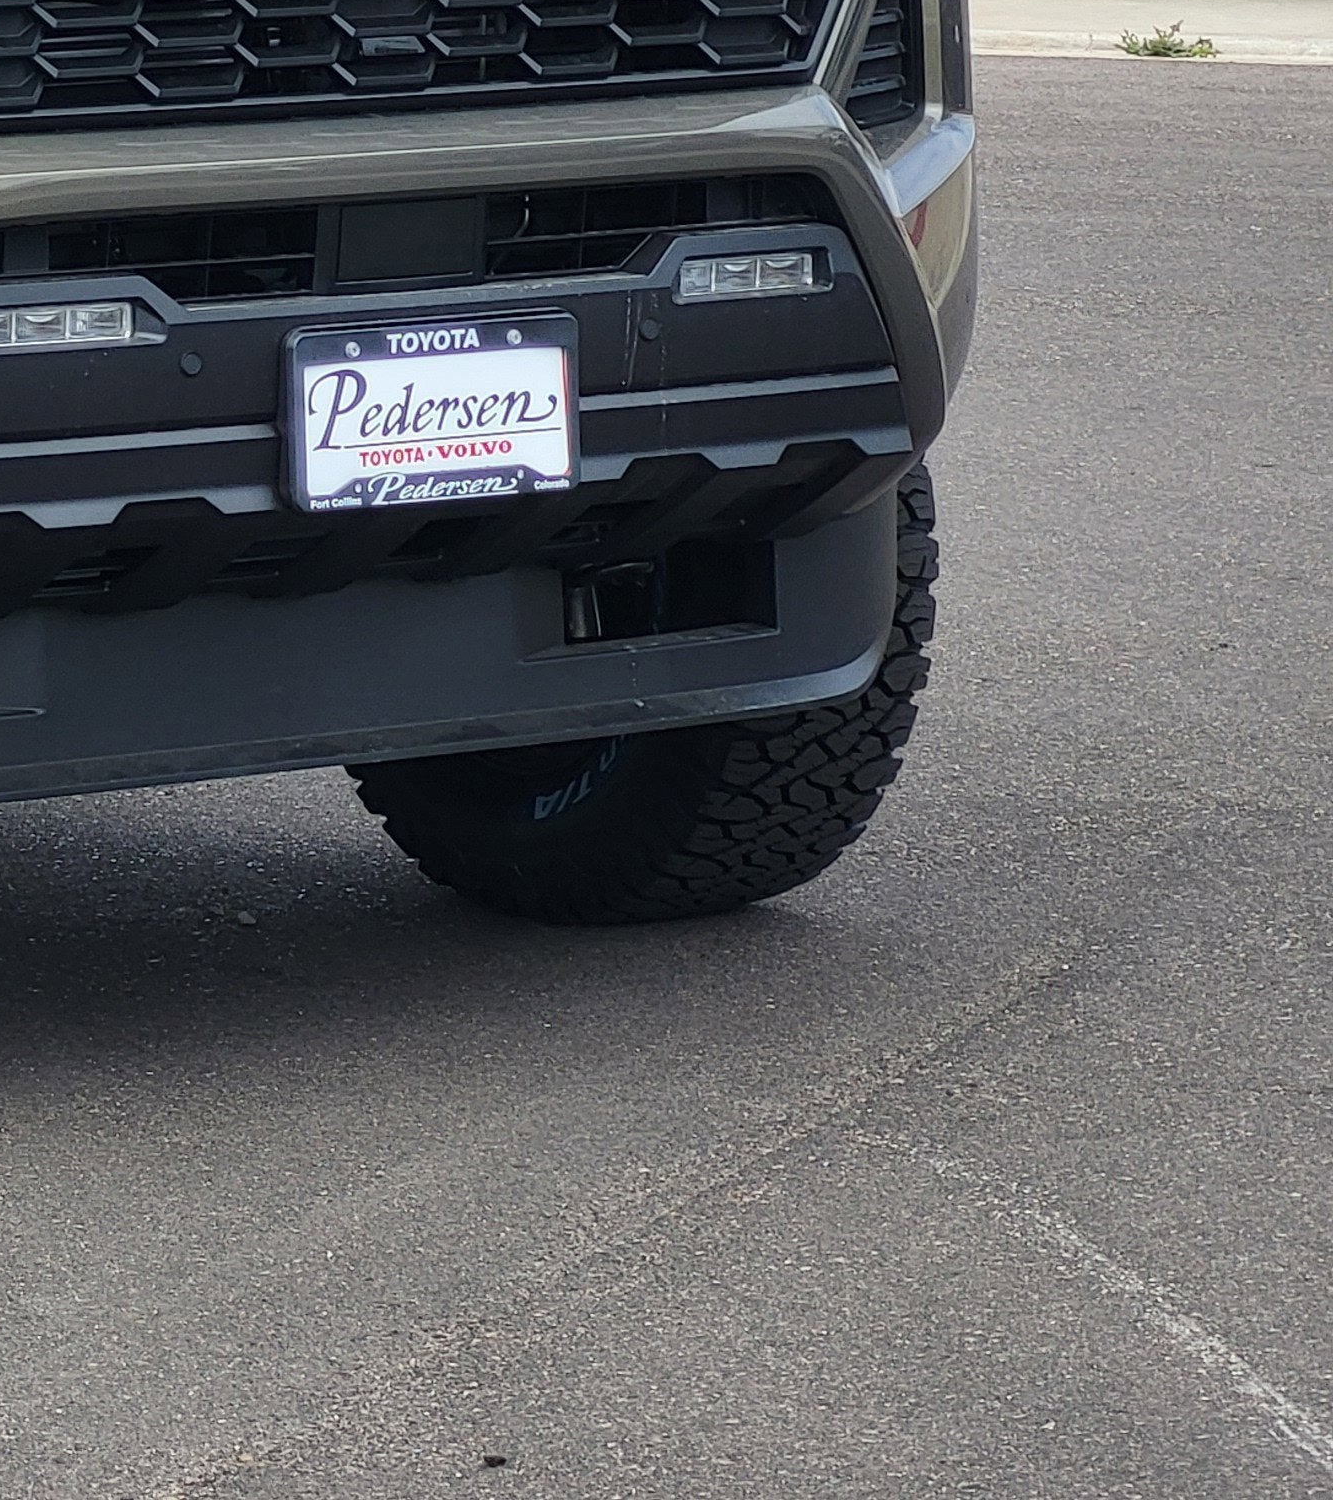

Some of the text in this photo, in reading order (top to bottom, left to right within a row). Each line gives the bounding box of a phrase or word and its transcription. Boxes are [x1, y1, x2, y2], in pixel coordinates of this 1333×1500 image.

[386, 327, 481, 355] TOYOTA
[309, 368, 558, 452] Pedersen
[358, 439, 513, 468] TOYOTA VOLVO
[310, 495, 363, 511] Fort Collins
[367, 471, 519, 506] Pedersen
